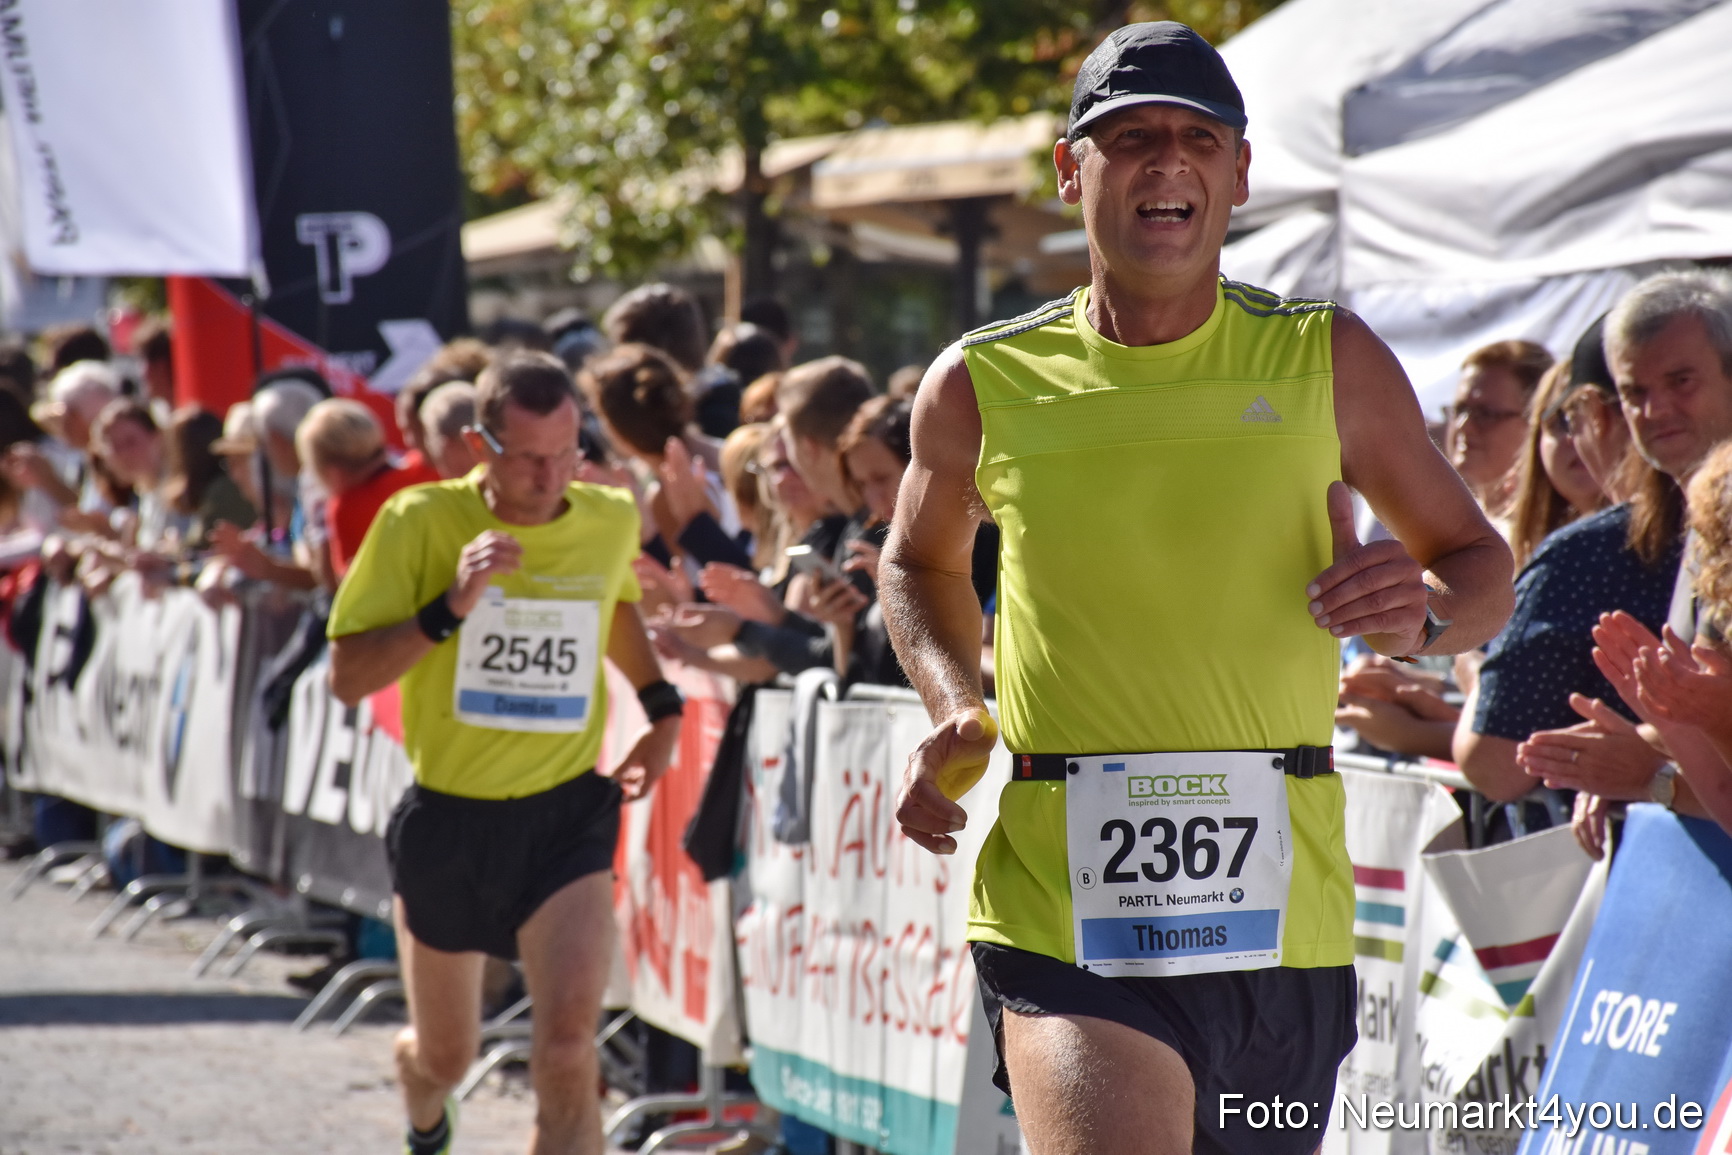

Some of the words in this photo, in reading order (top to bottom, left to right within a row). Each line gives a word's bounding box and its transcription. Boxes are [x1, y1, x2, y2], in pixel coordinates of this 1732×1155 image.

[481, 633, 578, 676] 2545
[1128, 774, 1229, 798] BOCK
[1128, 799, 1159, 807] inspired
[1161, 799, 1170, 807] by
[1100, 816, 1259, 884] 2367
[1119, 895, 1163, 908] PARTL
[1166, 891, 1225, 906] Neumarkt
[1133, 925, 1228, 951] Thomas
[1581, 988, 1678, 1058] STORE
